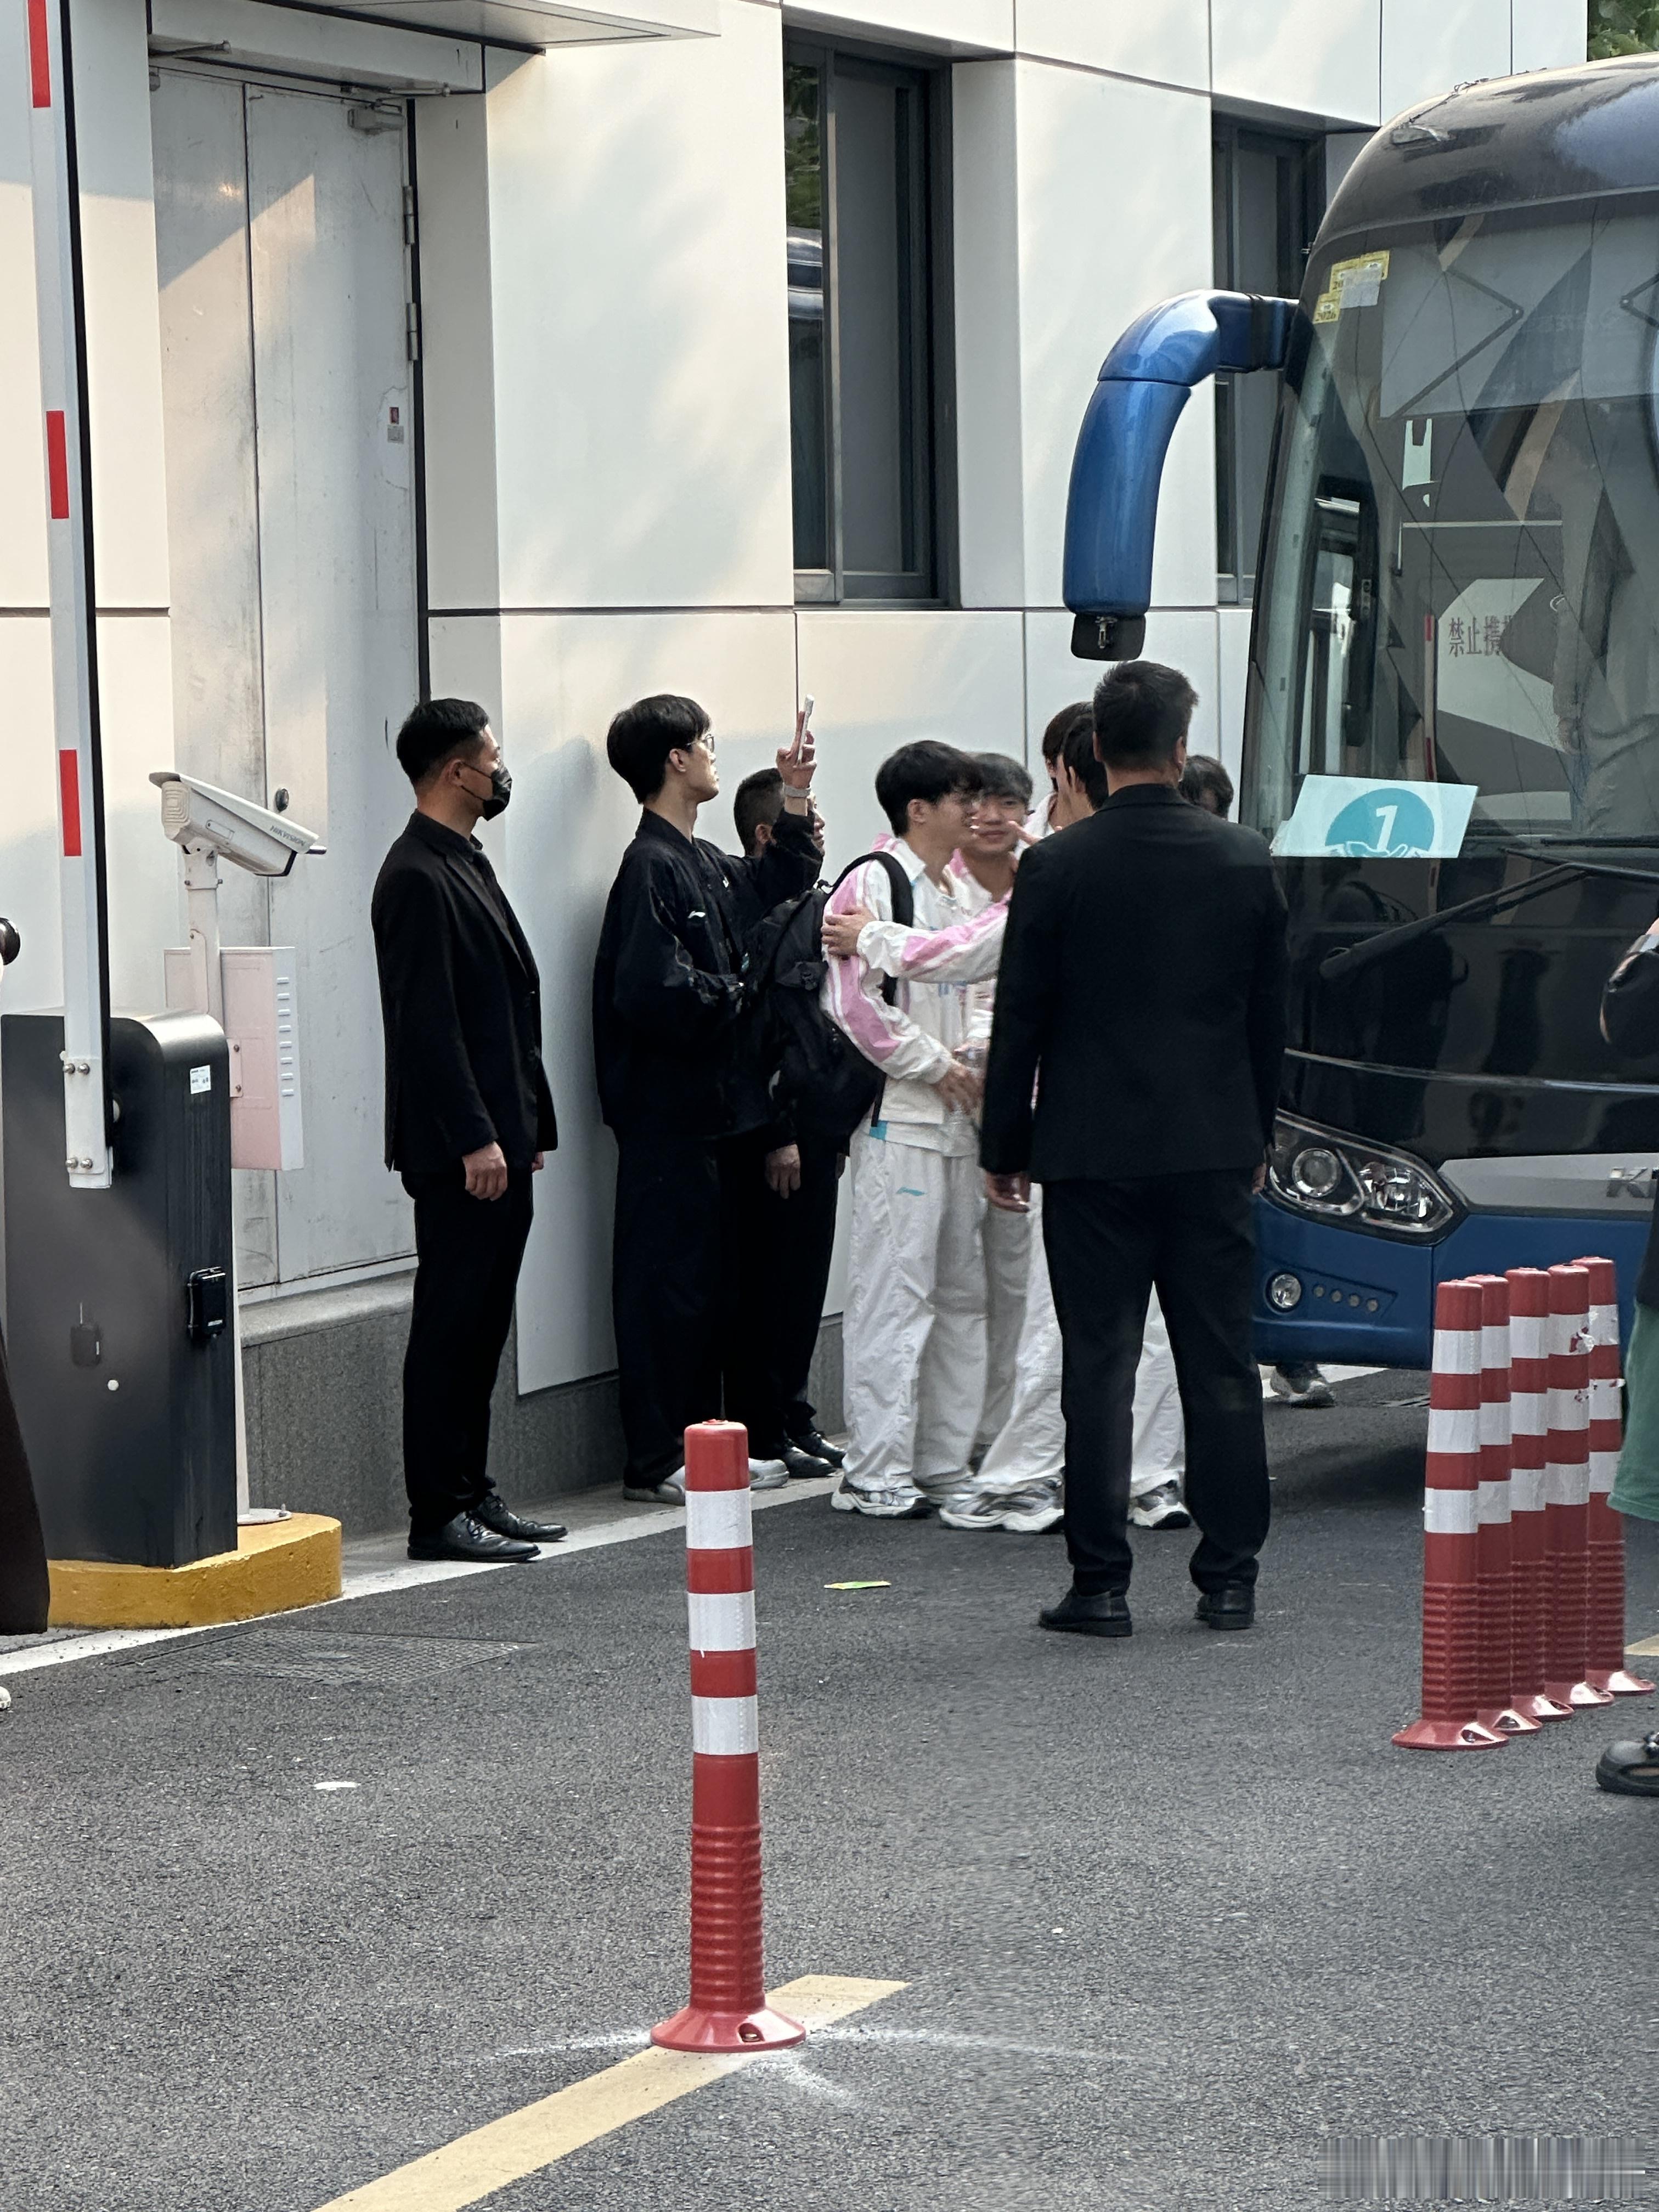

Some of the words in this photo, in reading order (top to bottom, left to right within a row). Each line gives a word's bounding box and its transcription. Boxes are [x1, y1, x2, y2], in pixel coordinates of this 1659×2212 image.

[1448, 615, 1513, 657] 禁止携
[269, 825, 306, 847] HIKVISION
[1376, 805, 1398, 851] 1
